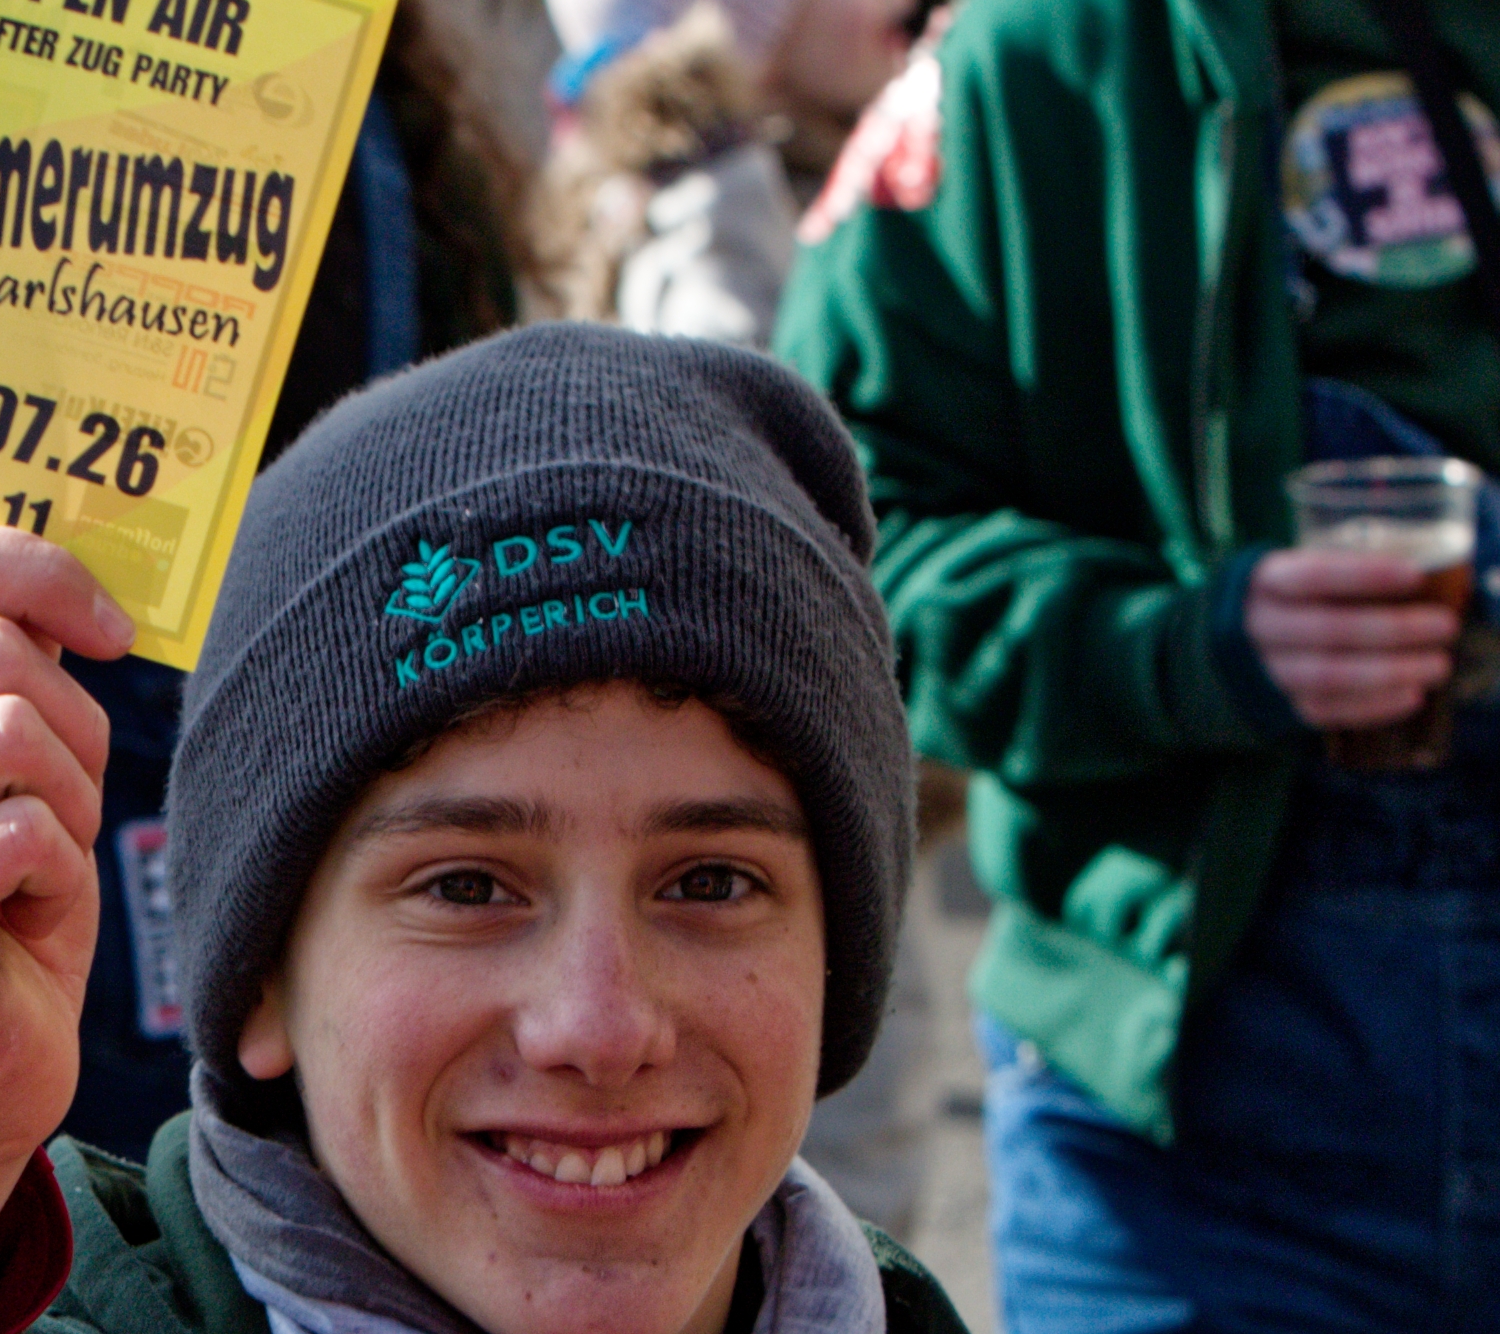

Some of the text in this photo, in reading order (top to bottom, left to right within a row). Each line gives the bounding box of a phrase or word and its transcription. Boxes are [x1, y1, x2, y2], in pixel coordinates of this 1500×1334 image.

[65, 36, 123, 78] ZUG
[131, 54, 229, 106] PARTY
[491, 519, 636, 578] DSV
[394, 588, 650, 689] KÖRPERICH
